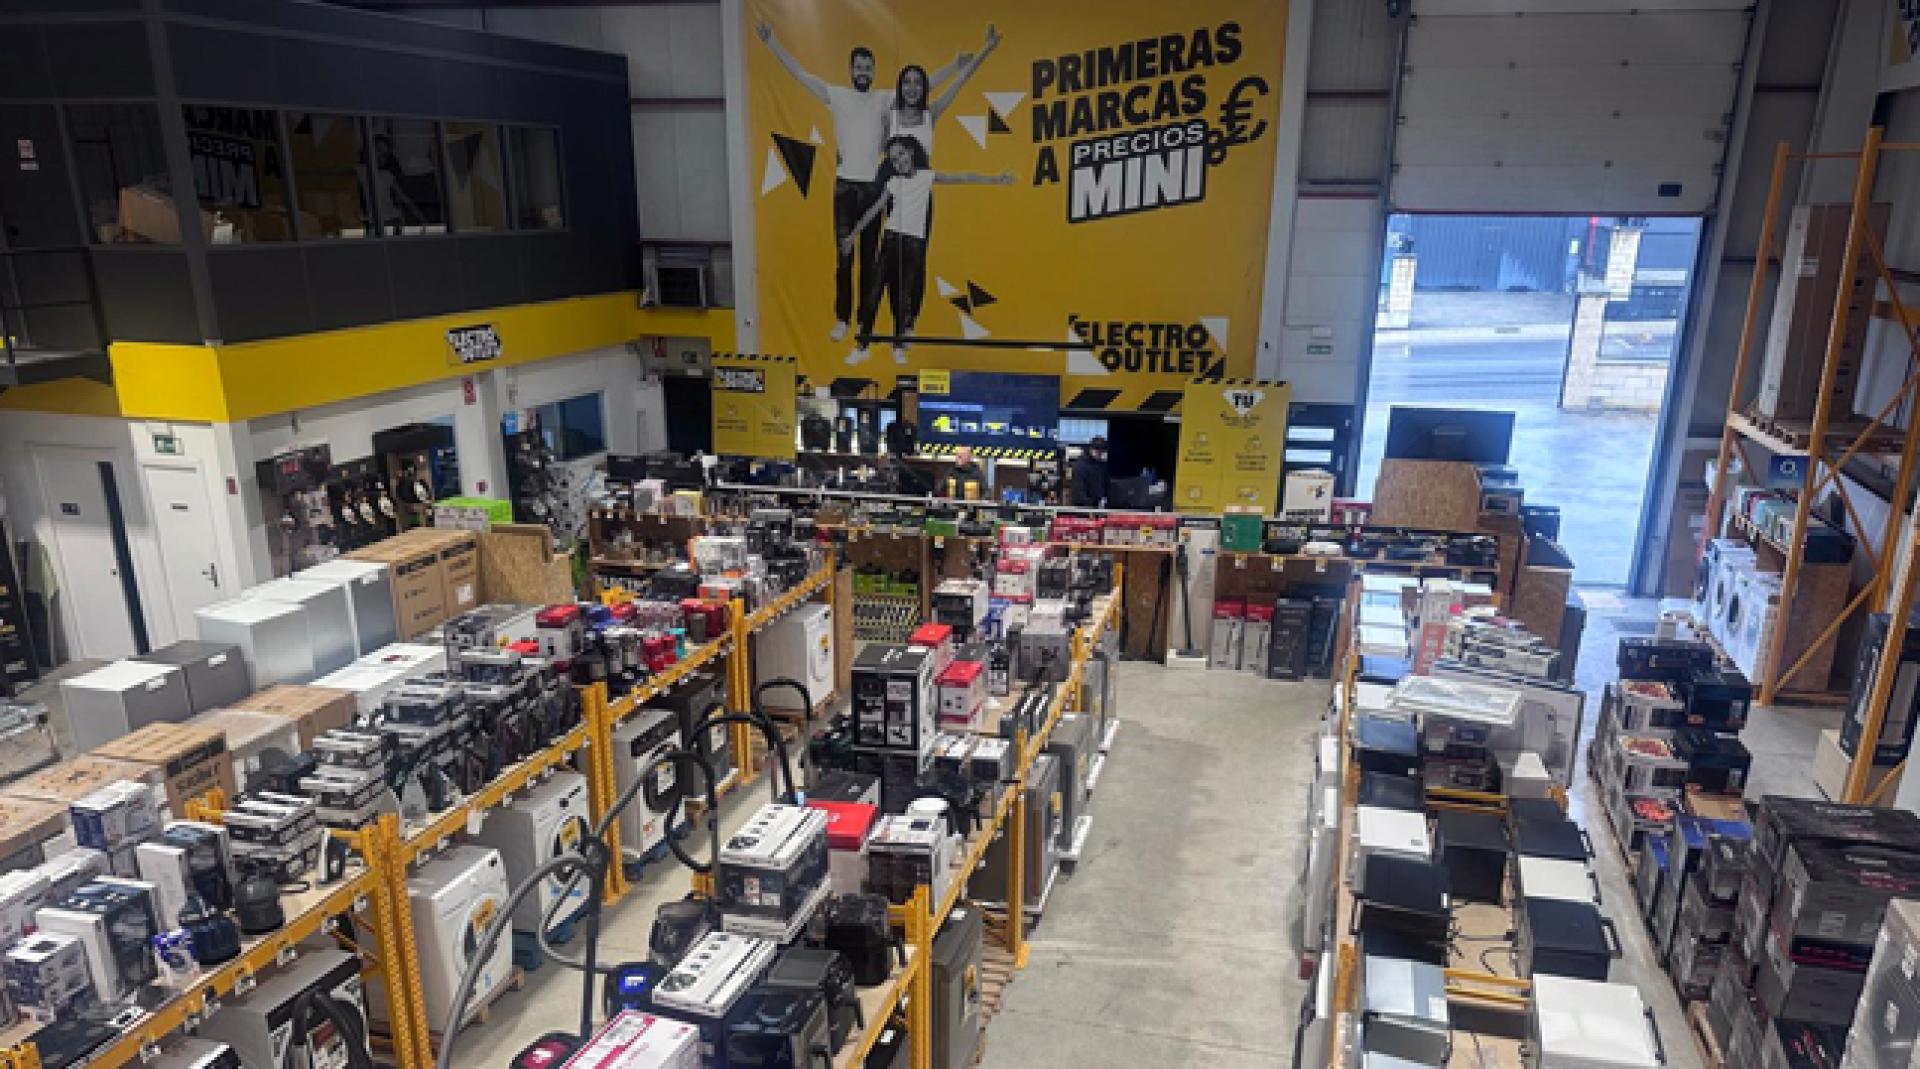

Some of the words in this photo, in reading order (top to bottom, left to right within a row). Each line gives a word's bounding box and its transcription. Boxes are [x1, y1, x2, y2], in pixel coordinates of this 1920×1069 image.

[1032, 22, 1242, 99] PRIMERAS
[1032, 74, 1206, 143] MARCAS
[1032, 146, 1060, 186] A
[1073, 124, 1205, 165] PRECIOS
[1070, 145, 1205, 219] MINI
[1073, 320, 1210, 347] ELECTRO
[1100, 348, 1215, 374] OUTLET
